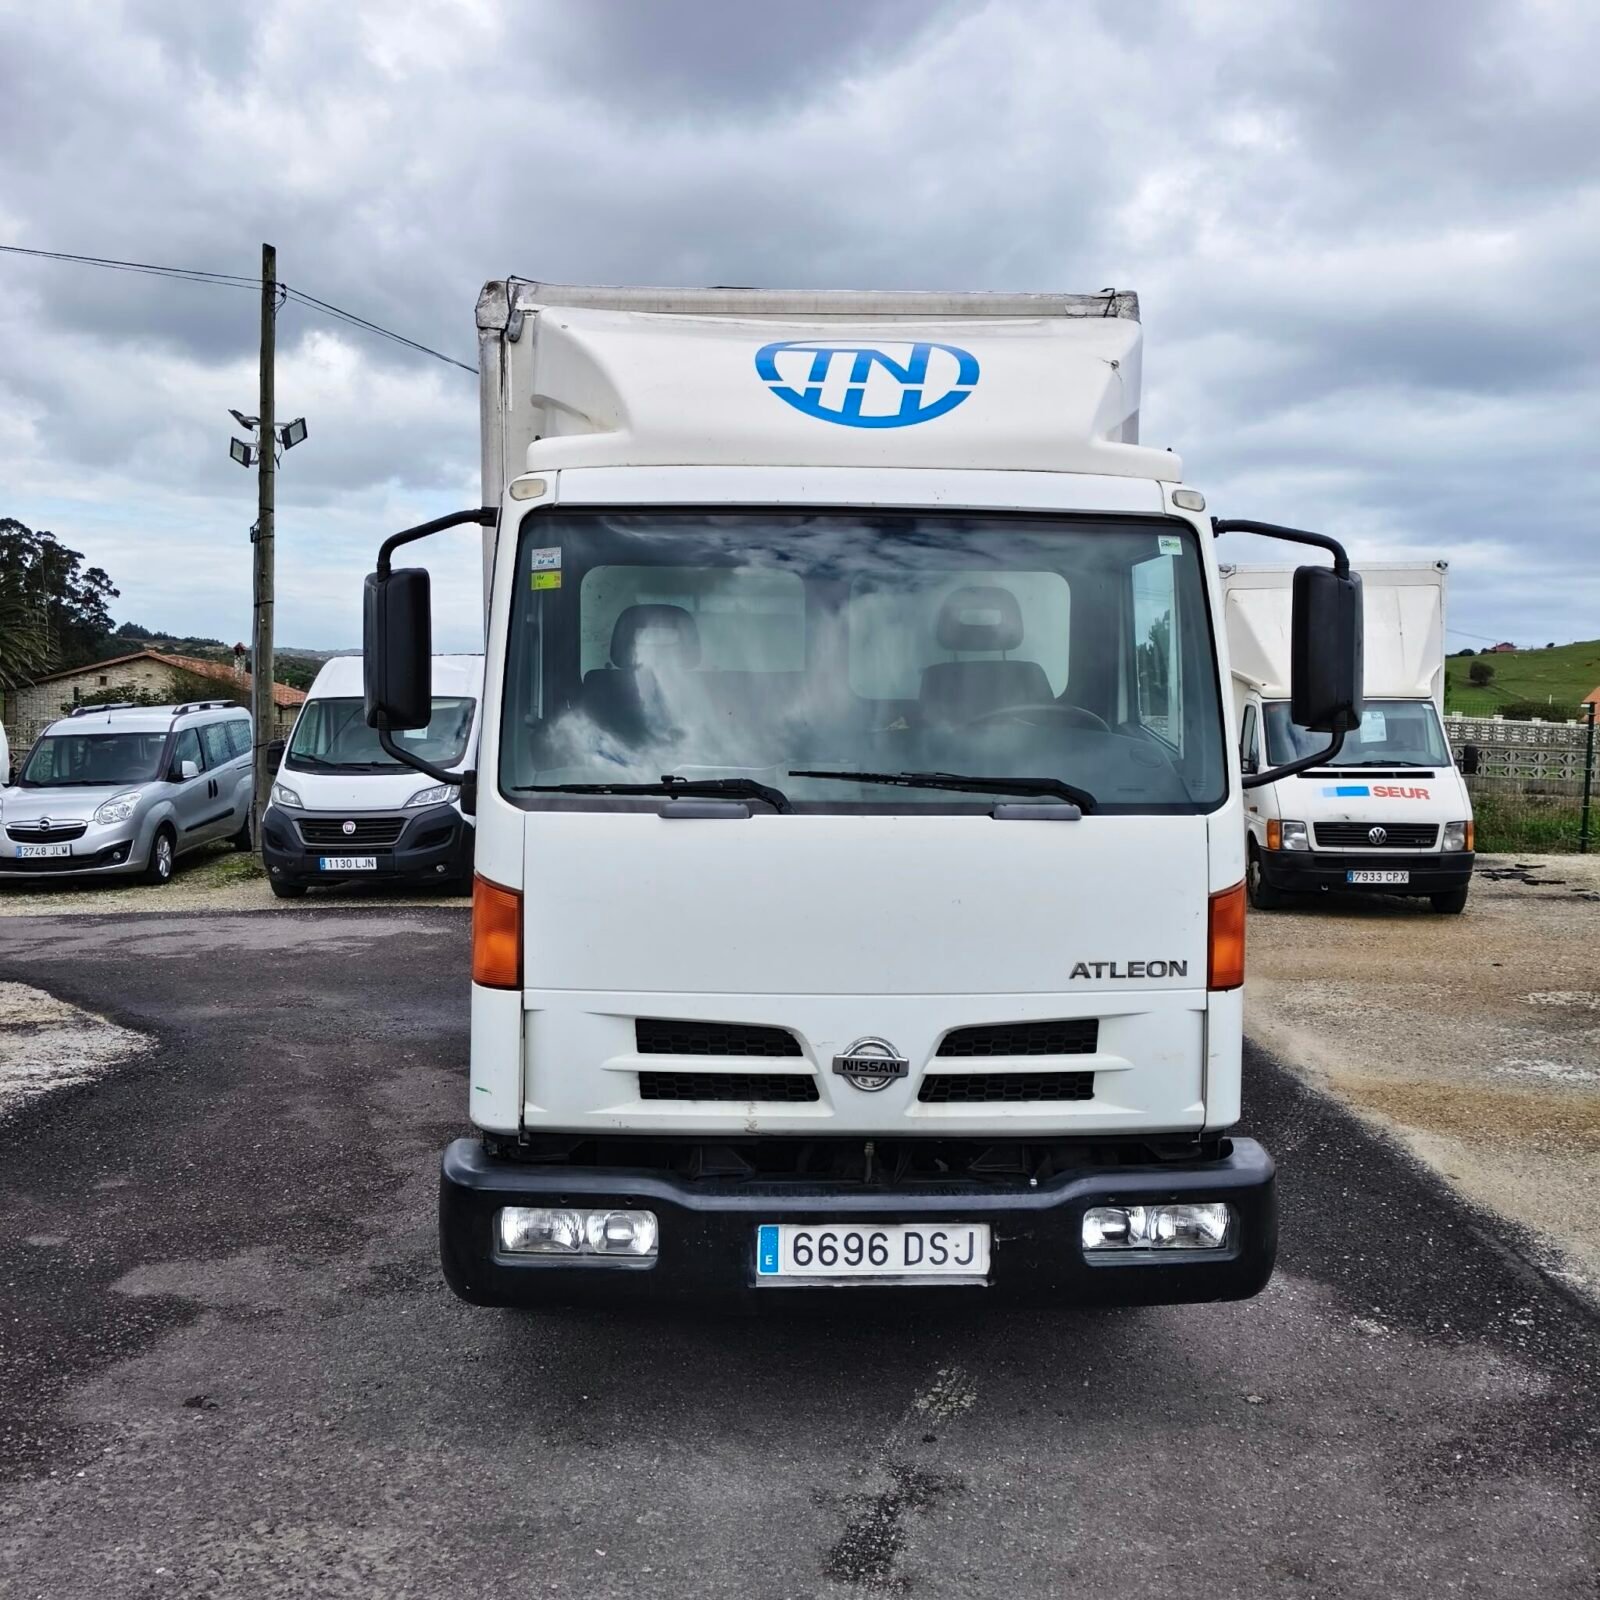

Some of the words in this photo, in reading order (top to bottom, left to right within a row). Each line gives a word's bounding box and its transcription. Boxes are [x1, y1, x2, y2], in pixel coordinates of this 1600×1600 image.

[1373, 786, 1430, 800] SEUR
[23, 847, 47, 857] 2748
[50, 846, 68, 856] JLM
[329, 859, 352, 868] 1130
[355, 858, 374, 868] LJN
[1355, 872, 1382, 882] 7933
[1386, 872, 1406, 882] CPX
[1069, 960, 1188, 979] ATLEON
[842, 1060, 900, 1073] NISSAN
[765, 1255, 773, 1265] E
[793, 1232, 889, 1266] 6696
[904, 1231, 974, 1266] DSJ
